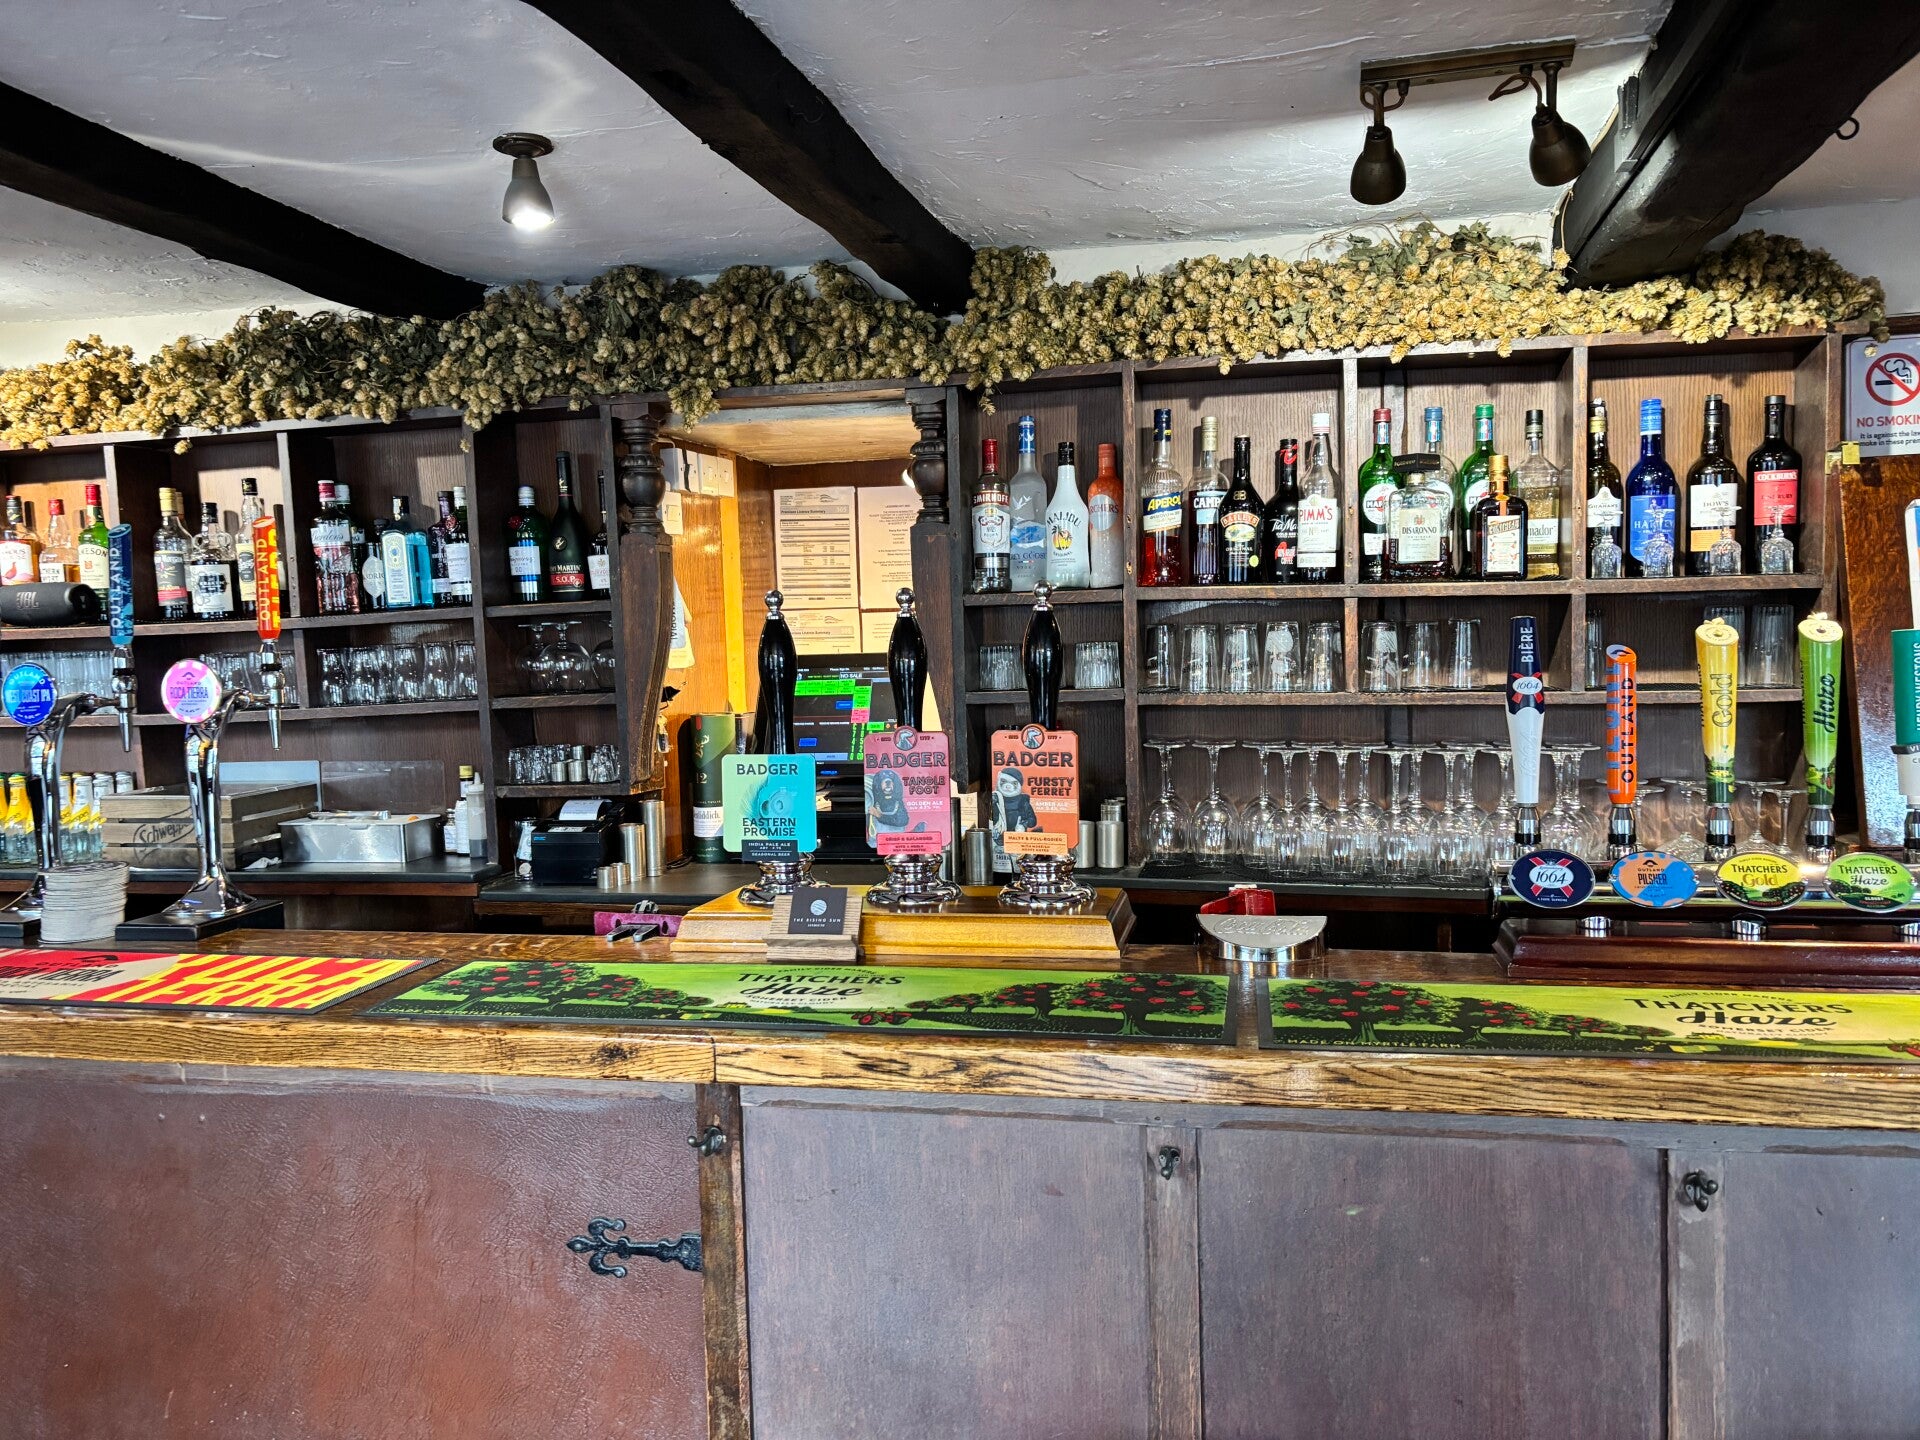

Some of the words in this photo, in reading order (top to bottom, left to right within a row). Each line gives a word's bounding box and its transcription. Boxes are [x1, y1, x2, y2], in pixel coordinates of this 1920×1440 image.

[1856, 417, 1875, 427] NO
[972, 493, 1009, 504] SMIRNOFF
[1193, 496, 1222, 509] CAMP
[1089, 503, 1120, 514] RCHERS
[1299, 507, 1334, 522] PIMM'S
[1046, 511, 1082, 528] MALIBU
[1402, 526, 1437, 535] DISARONNO
[256, 538, 271, 621] OUTLAND
[110, 547, 122, 628] OUTLAND
[16, 591, 40, 609] JBL
[1518, 626, 1533, 663] BIÈRE
[9, 671, 46, 685] OUTLAND
[170, 686, 186, 699] ROCA
[187, 686, 209, 699] TIERRA
[1516, 682, 1539, 691] 1664
[1709, 673, 1733, 727] Gold
[1812, 673, 1836, 734] Haze
[1621, 677, 1635, 783] OUTLAND
[865, 751, 947, 769] BADGER
[993, 751, 1075, 768] BADGER
[736, 763, 799, 776] BADGER
[902, 776, 945, 787] TANGLE
[1027, 776, 1075, 787] FURSTY
[909, 786, 939, 796] FOOT
[1030, 787, 1072, 797] FERRET
[742, 817, 796, 827] EASTERN
[743, 827, 796, 837] PROMISE
[1731, 863, 1788, 874] THATCHERS
[1838, 864, 1898, 875] THATCHERS
[1535, 871, 1568, 885] 1664
[1637, 873, 1668, 886] PILSNER
[1742, 873, 1779, 888] Gold
[1850, 875, 1889, 886] Haze
[737, 972, 906, 985] THATCHERS
[739, 983, 864, 997] Haze
[745, 994, 806, 1003] SOMERSET
[1624, 998, 1854, 1015] THATCHERS
[1676, 1010, 1838, 1027] Haze
[1699, 1023, 1783, 1033] SOMERSET
